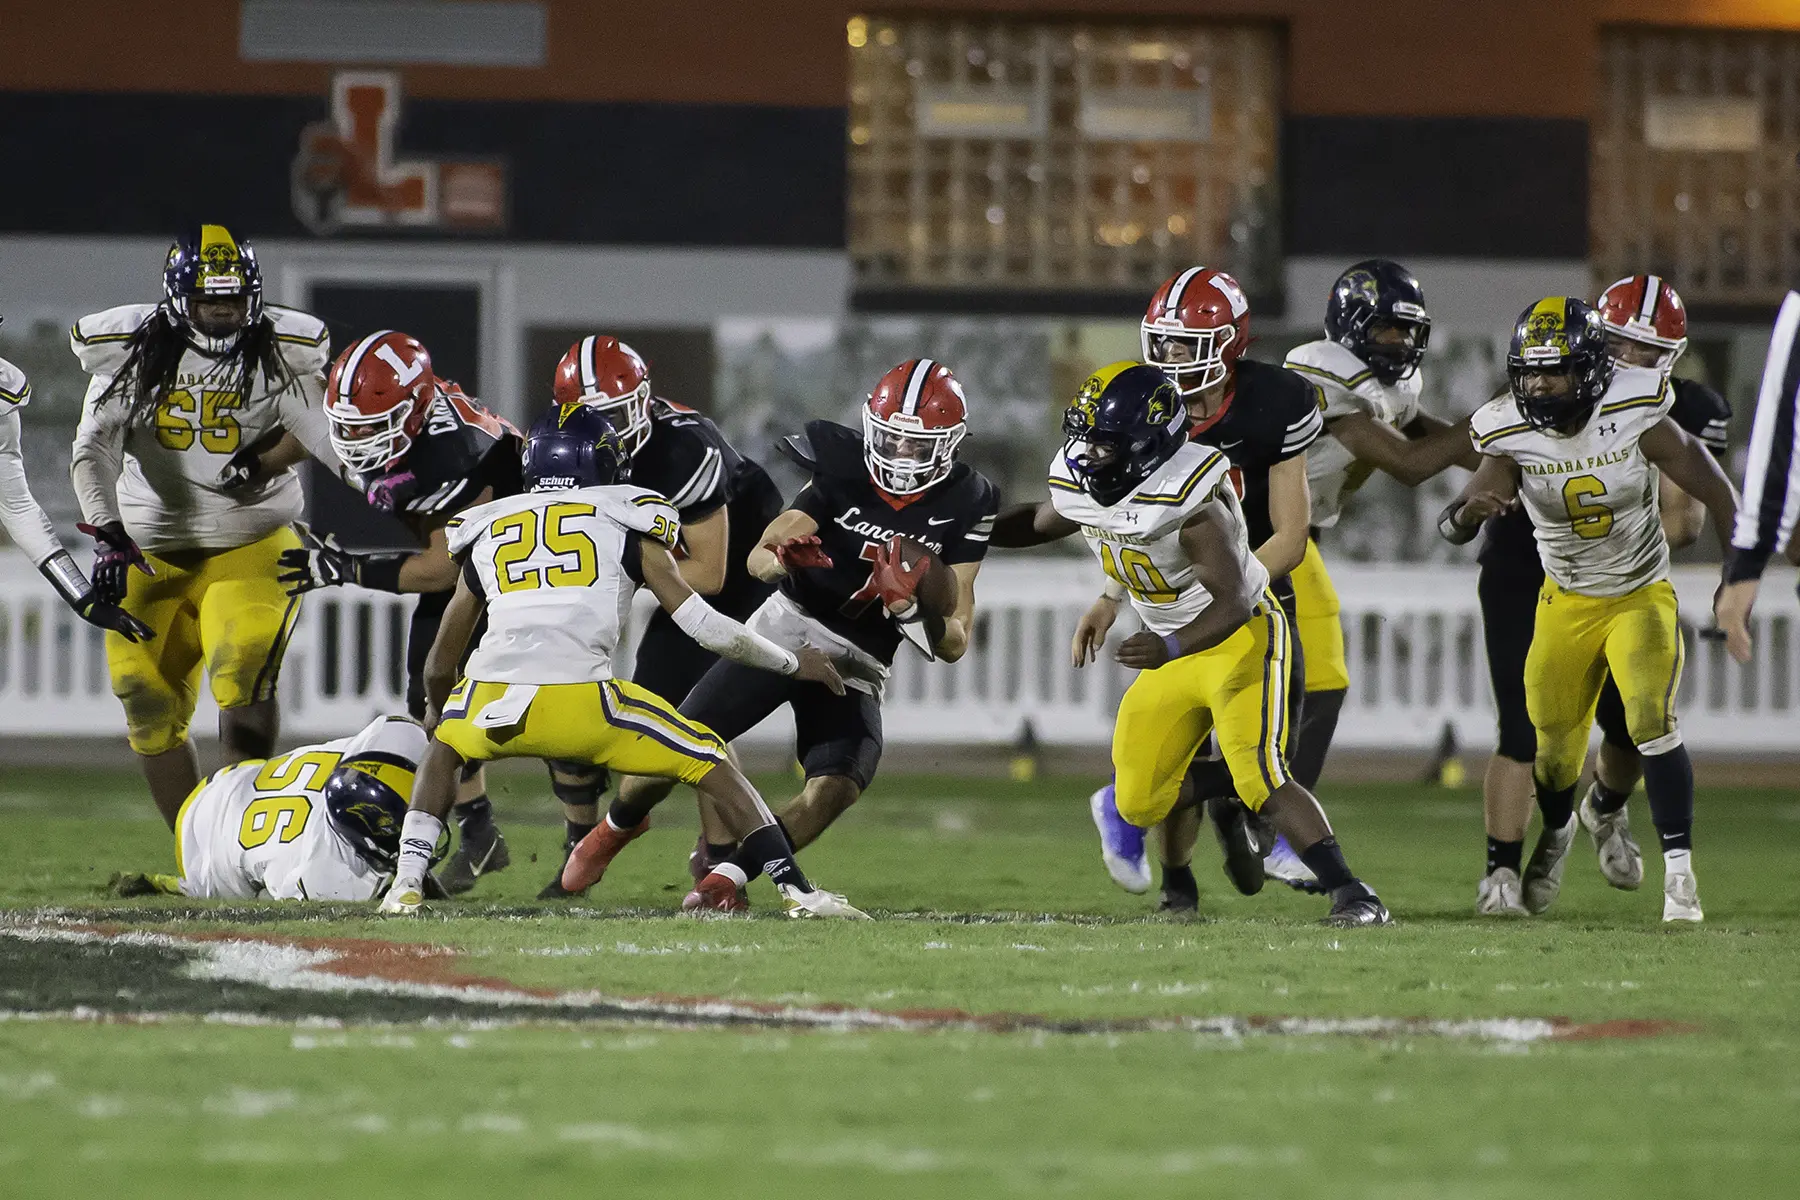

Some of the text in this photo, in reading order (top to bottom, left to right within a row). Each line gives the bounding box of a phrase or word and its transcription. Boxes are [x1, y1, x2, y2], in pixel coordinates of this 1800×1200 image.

[374, 343, 423, 387] L
[154, 389, 242, 454] 65
[540, 475, 575, 486] schutt
[1587, 448, 1630, 469] FALLS
[648, 513, 680, 548] 25
[1561, 473, 1615, 540] 6
[490, 502, 599, 594] 25
[1100, 541, 1181, 605] 10
